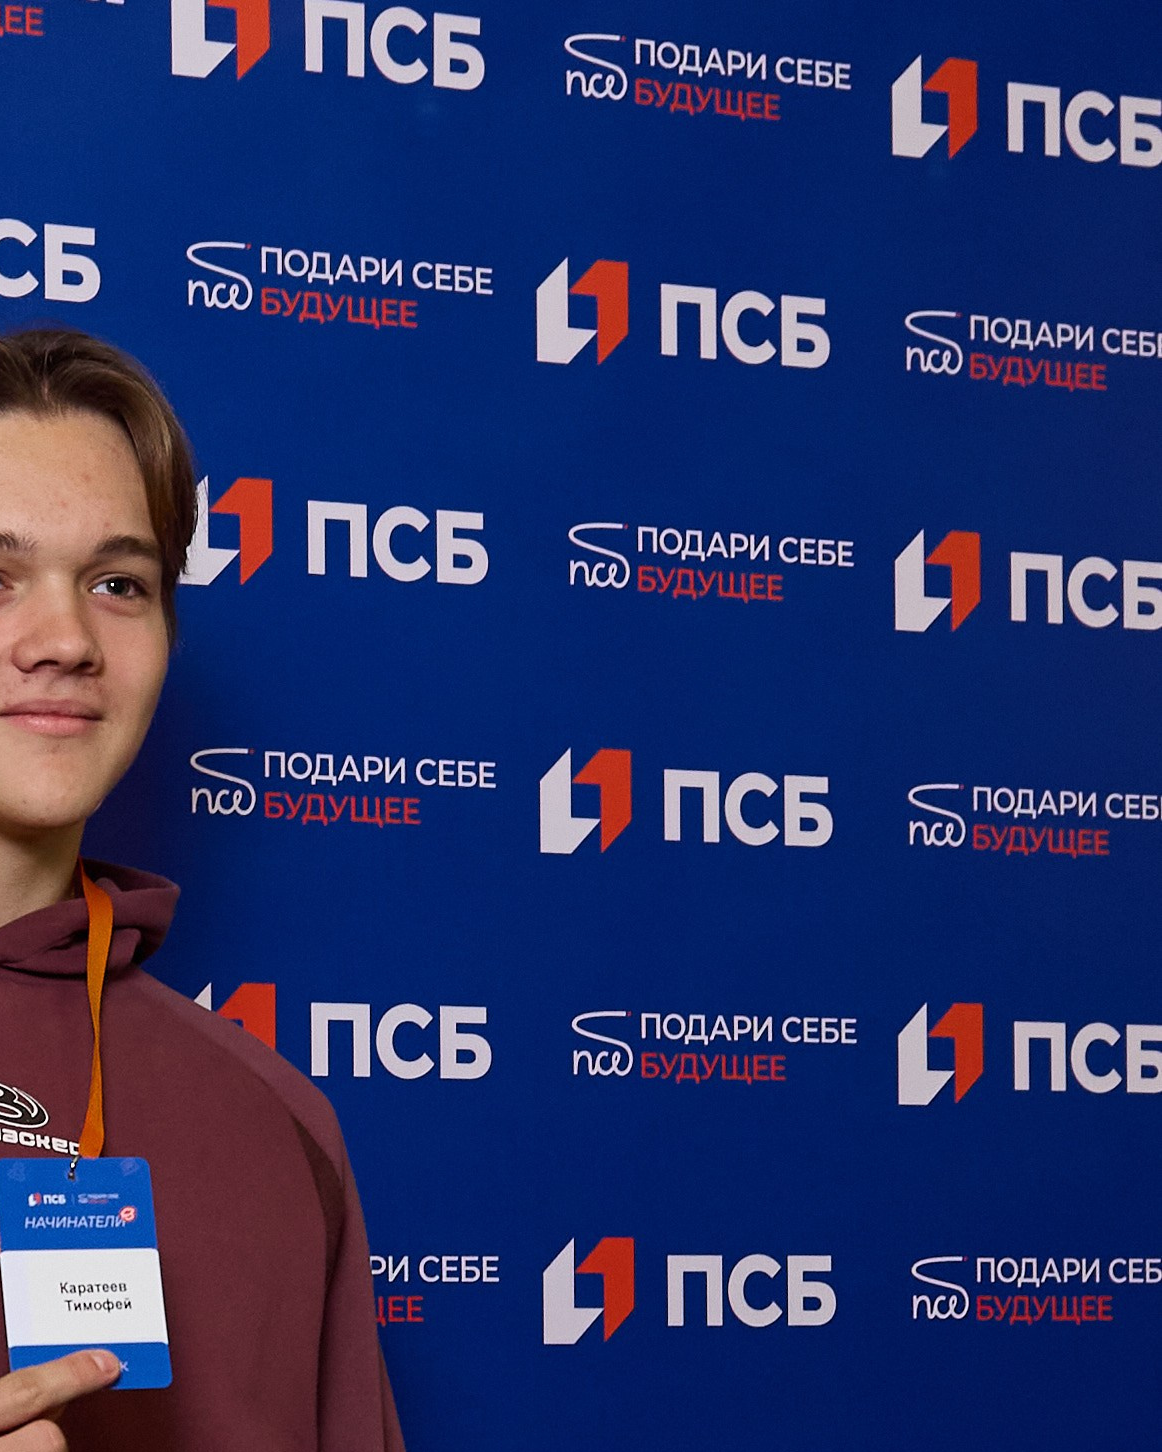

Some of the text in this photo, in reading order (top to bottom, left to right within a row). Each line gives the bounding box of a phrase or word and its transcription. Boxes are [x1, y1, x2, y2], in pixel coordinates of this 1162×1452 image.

[304, 0, 485, 90] ПСБ
[635, 39, 851, 90] ПОДАРИ СЕБЕ
[635, 78, 779, 120] БУДУЩЕЕ
[1007, 82, 1162, 167] ПСБ
[261, 246, 493, 295] ПОДАРИ СЕБЕ
[262, 288, 417, 328] БУДУЩЕЕ
[661, 283, 830, 368] ПСБ
[970, 315, 1093, 351] ПОДАРИ
[970, 353, 1106, 390] БУДУЩЕЕ
[308, 500, 488, 584] ПСБ
[638, 526, 854, 567] ПОДАРИ СЕБЕ
[638, 566, 782, 602] БУДУЩЕЕ
[1011, 552, 1162, 630] ПСБ
[265, 751, 496, 788] ПОДАРИ СЕБЕ
[264, 792, 420, 827] БУДУЩЕЕ
[664, 769, 833, 847] ПСБ
[973, 786, 1162, 820] ПОДАРИ СЕБ
[973, 824, 1108, 858] БУДУЩЕЕ
[311, 1002, 492, 1079] ПСБ
[641, 1013, 857, 1045] ПОДАРИ СЕБЕ
[641, 1052, 785, 1084] БУДУЩЕЕ
[1014, 1021, 1162, 1093] ПСБ
[24, 1215, 126, 1229] НАЧИНАТЕЛИ
[419, 1256, 499, 1282] СЕБЕ
[977, 1258, 1162, 1288] ПОДАРИ СЕБ
[59, 1282, 127, 1296] Каратеев
[64, 1298, 132, 1313] Тимофей
[667, 1254, 836, 1327] ПСБ
[977, 1296, 1112, 1324] БУДУЩЕЕ
